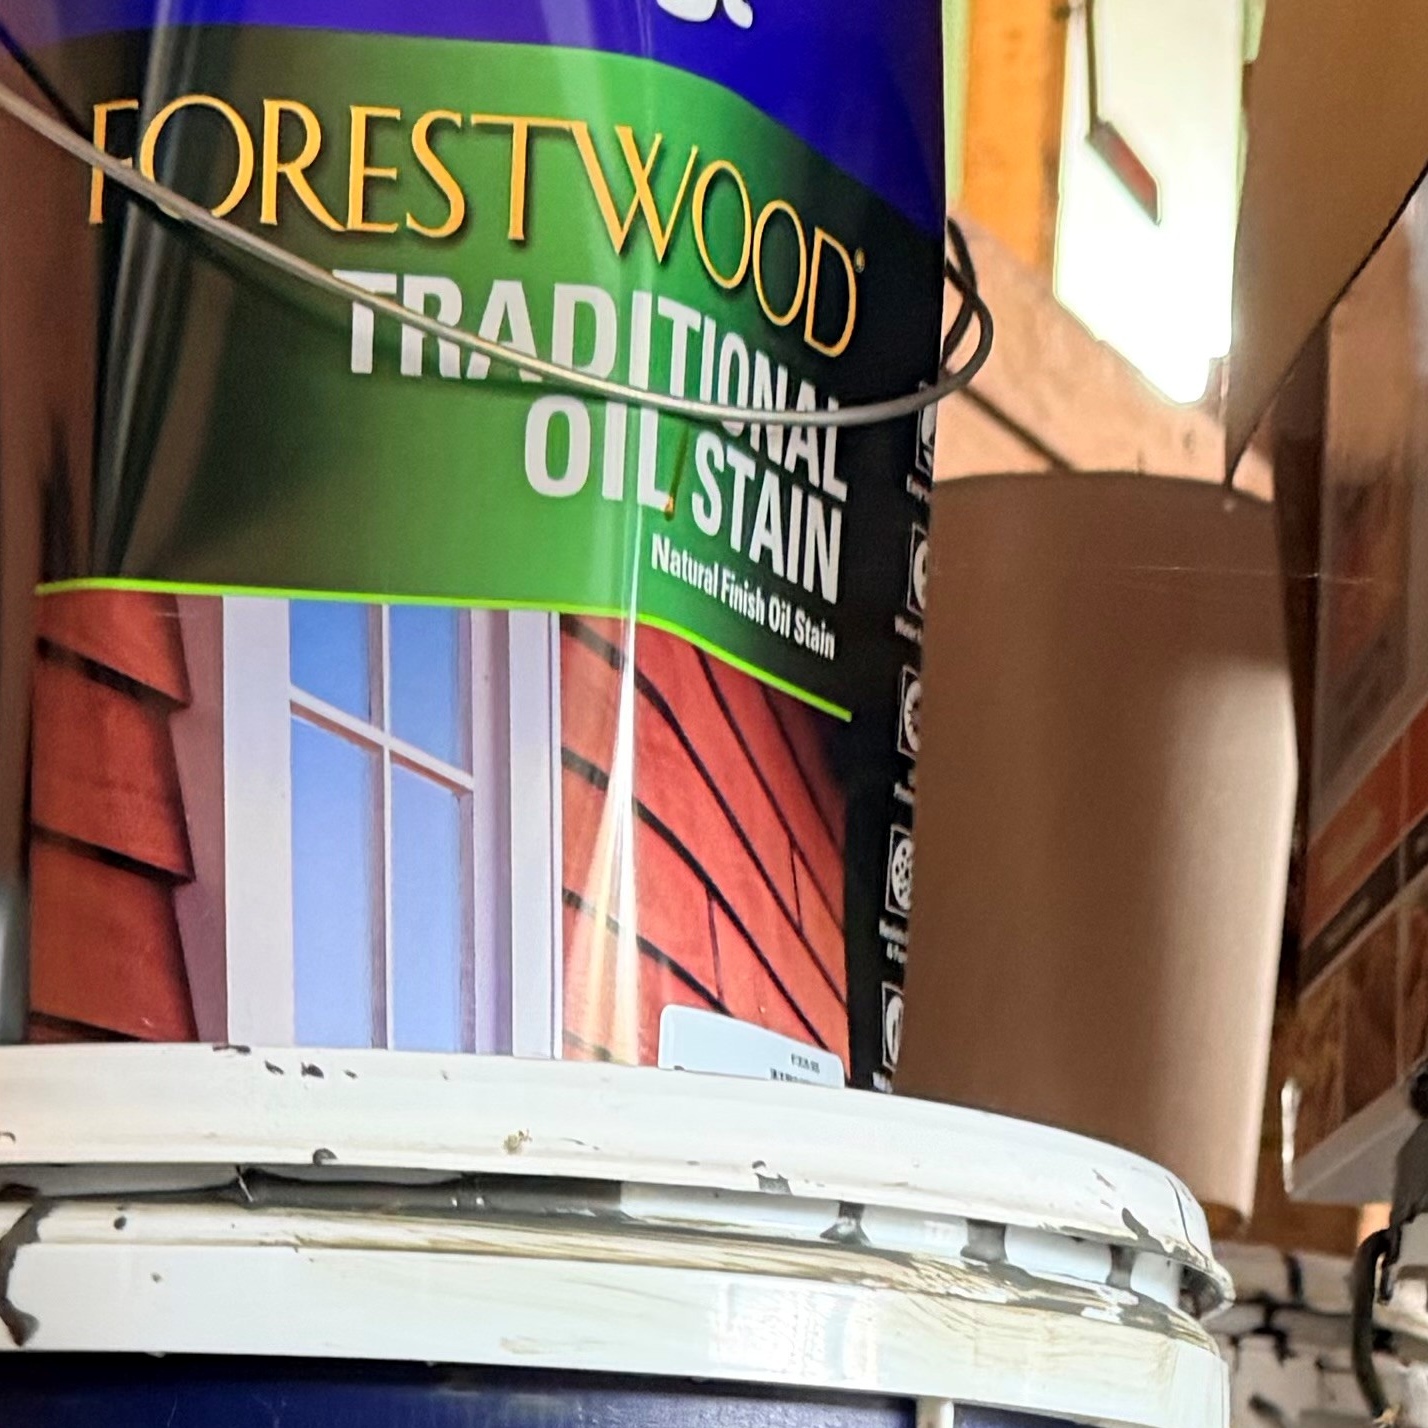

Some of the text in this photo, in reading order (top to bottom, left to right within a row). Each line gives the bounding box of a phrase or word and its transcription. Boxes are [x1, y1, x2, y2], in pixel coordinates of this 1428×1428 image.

[87, 93, 860, 359] FORESTWOOD
[332, 268, 848, 503] TRADITIONAL
[524, 393, 842, 605] OIL STAIN
[650, 532, 719, 595] Natural
[721, 566, 768, 621] Finish
[768, 594, 794, 638] Oil
[794, 605, 837, 662] Stain
